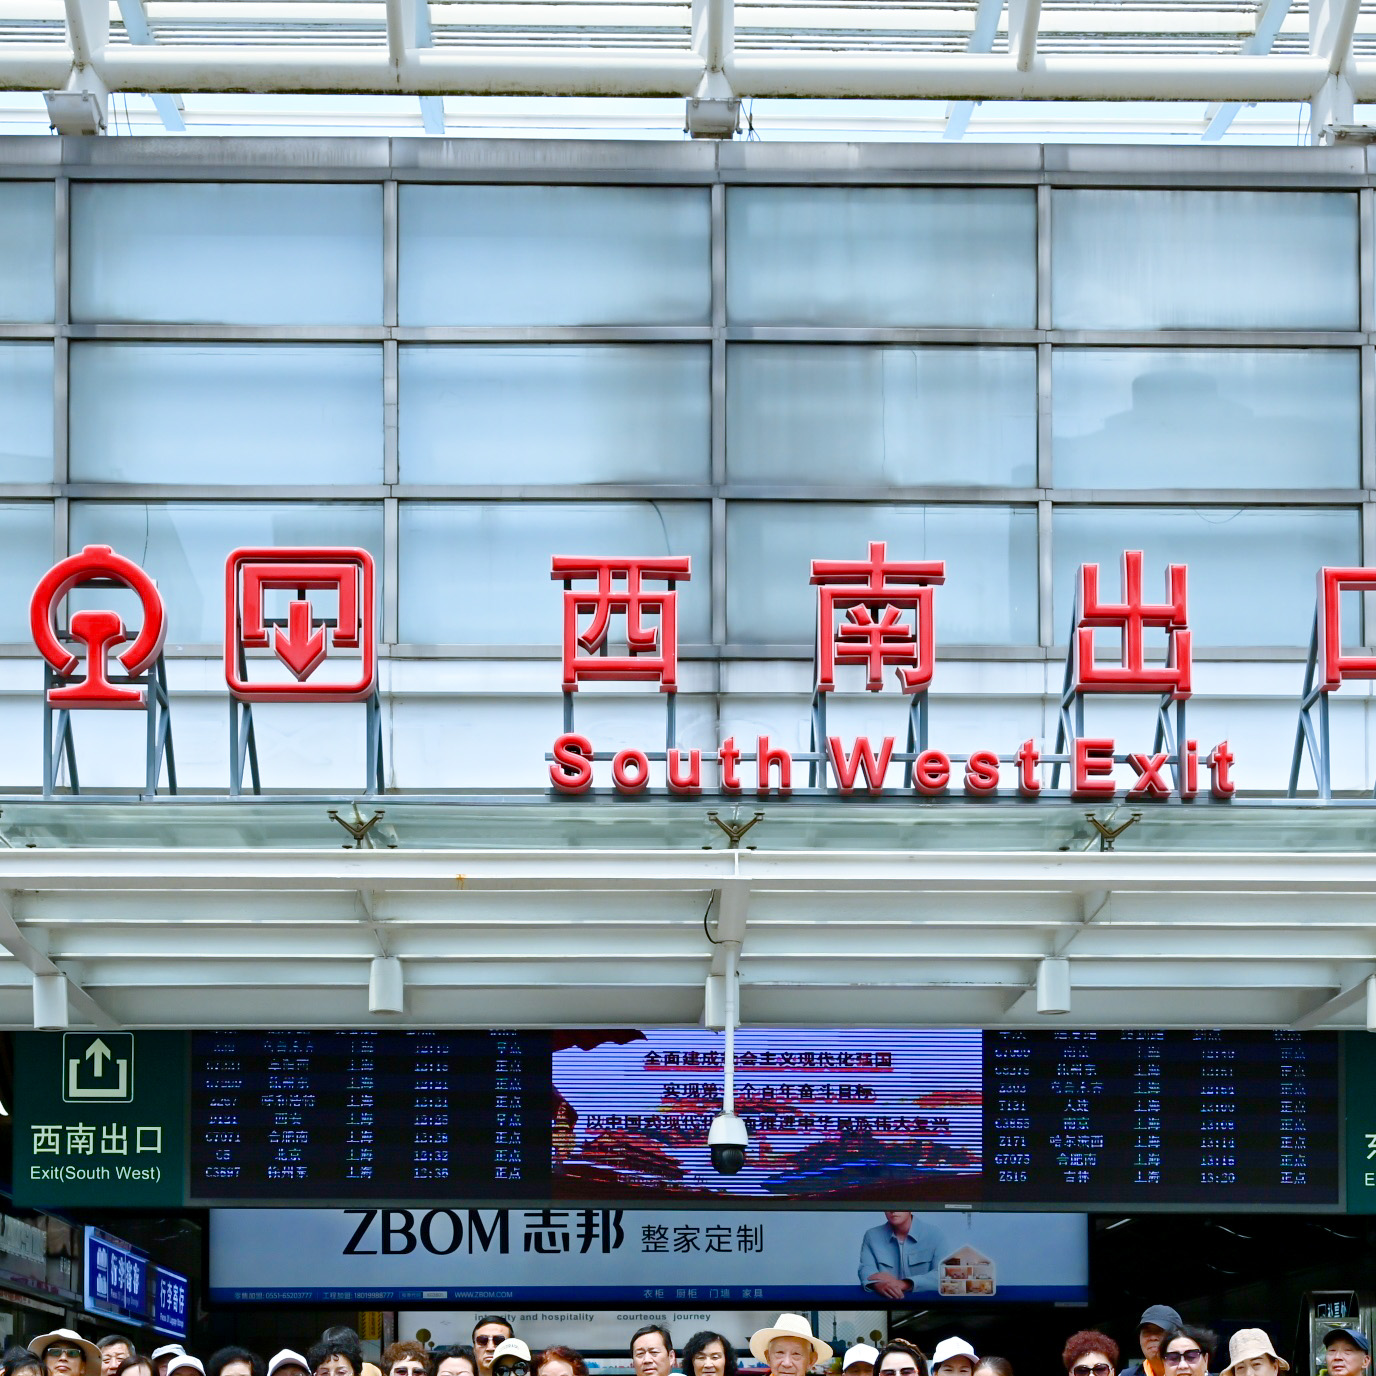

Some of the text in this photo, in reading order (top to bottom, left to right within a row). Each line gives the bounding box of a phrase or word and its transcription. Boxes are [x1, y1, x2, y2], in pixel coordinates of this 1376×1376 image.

[548, 733, 1236, 800] South West Exit
[643, 1051, 894, 1068] 全面建成会主义现代化强国
[30, 1121, 162, 1155] 西南出口
[29, 1165, 161, 1183] Exit(South West)
[341, 1209, 511, 1256] ZBOM
[523, 1209, 765, 1255] 志邦 整家定制
[520, 1313, 538, 1321] and
[541, 1312, 595, 1323] hospitality
[616, 1312, 712, 1323] courteous journey
